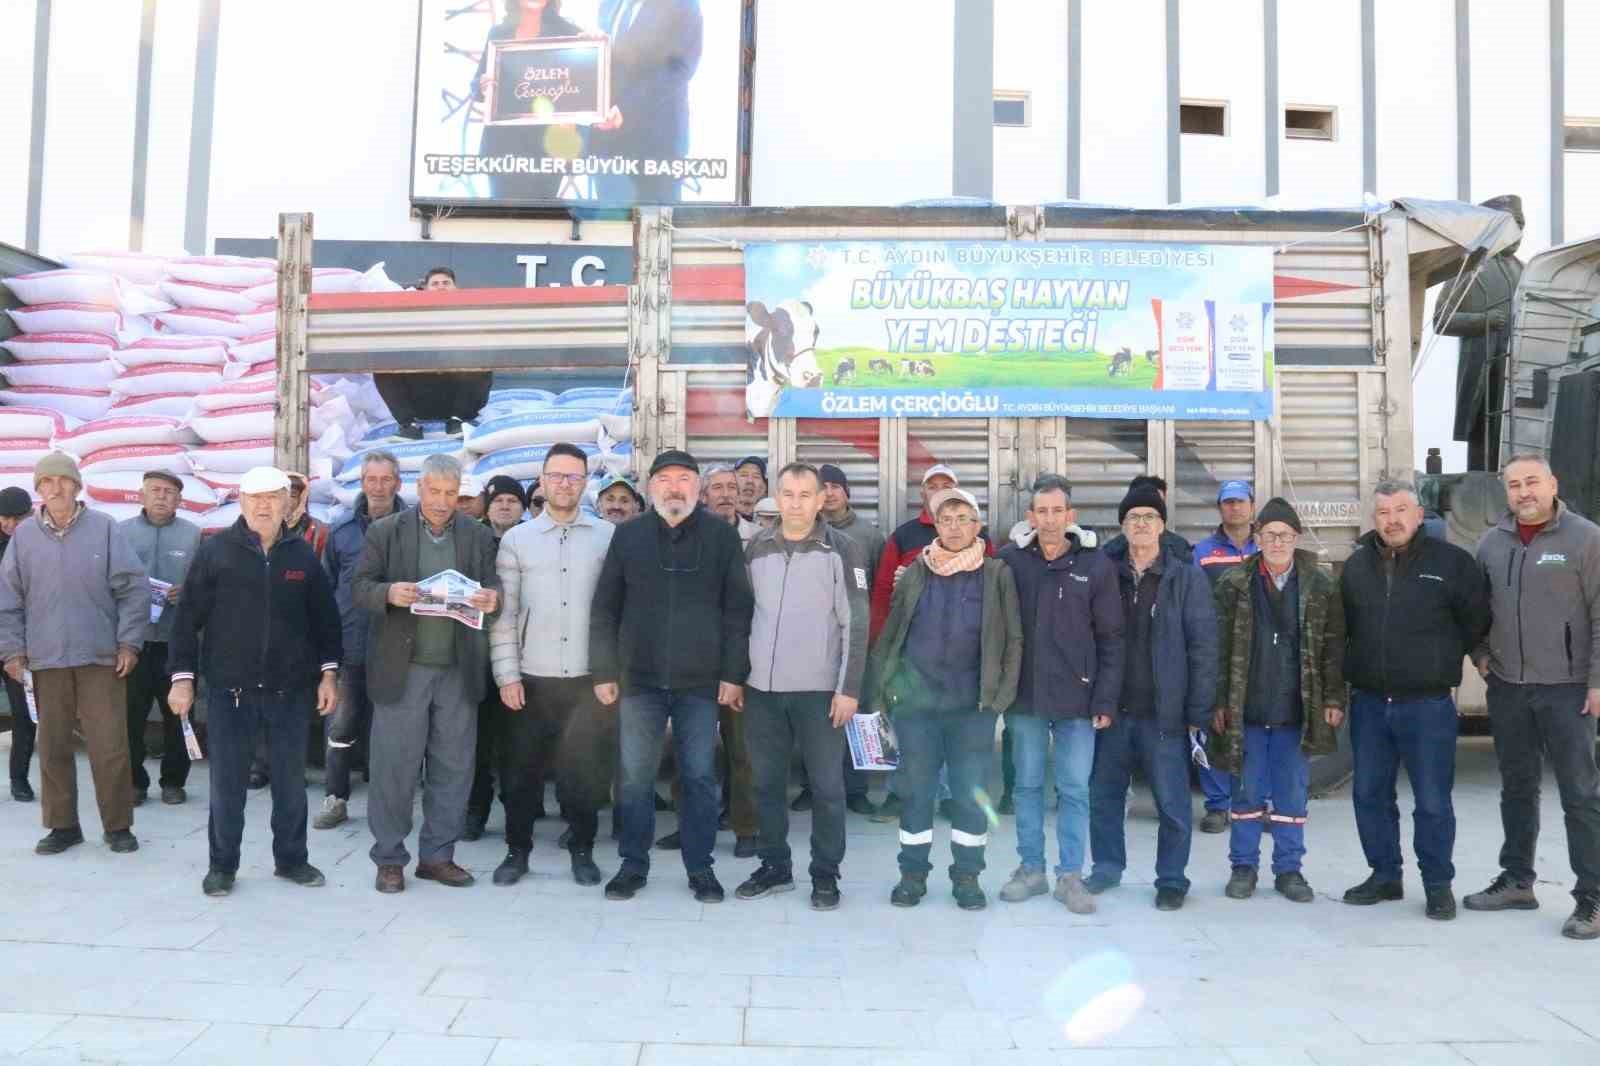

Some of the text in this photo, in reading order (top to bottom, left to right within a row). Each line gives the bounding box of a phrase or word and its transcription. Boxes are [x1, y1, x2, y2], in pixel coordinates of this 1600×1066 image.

[524, 65, 570, 81] ÖZLEM
[425, 154, 727, 178] TEŞEKKÜRLER BÜYÜK BAŞKAN
[841, 245, 1216, 268] T.C. AYDIN BÜYÜKŞEHİR BELEDİYESİ
[851, 270, 1131, 316] BÜYÜKBAŞ HAYVAN
[886, 309, 1100, 353] YEM DESTEĞİ
[821, 391, 887, 413] ÖZLEM
[891, 391, 999, 417] ÇERÇİOĞLU
